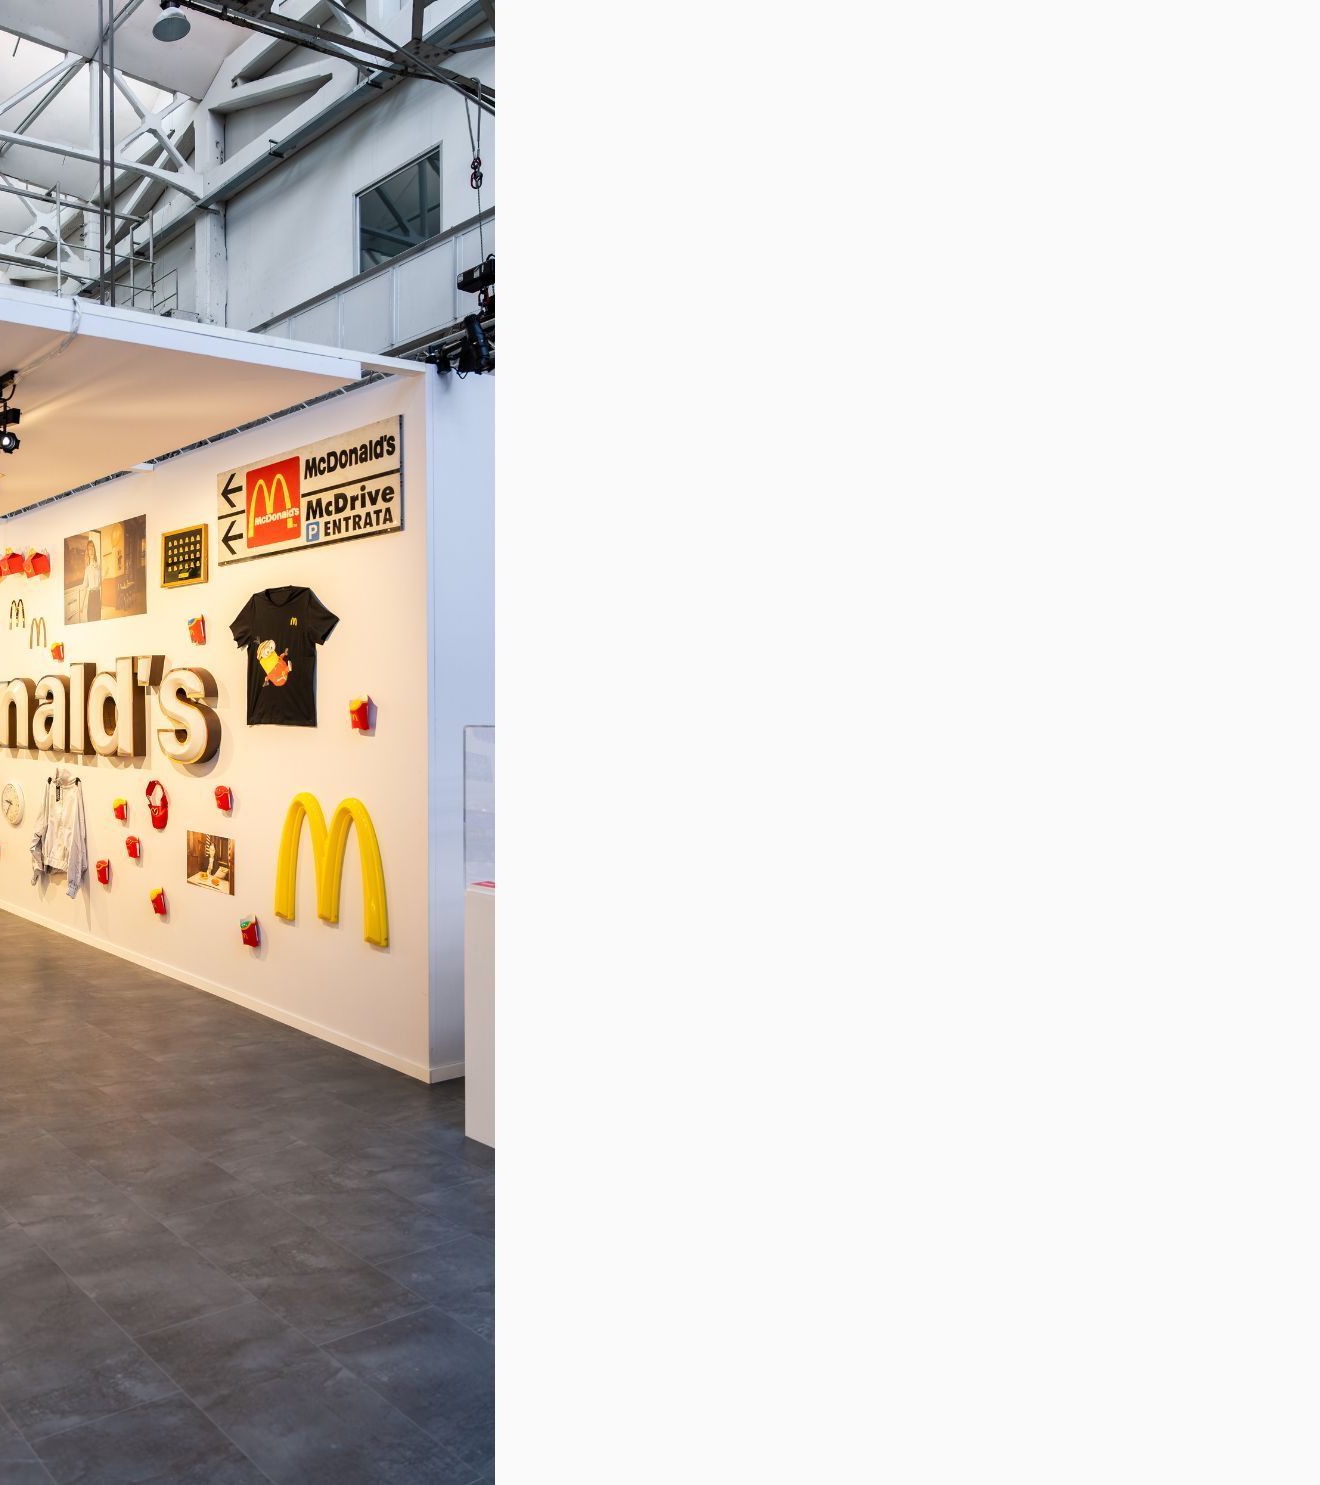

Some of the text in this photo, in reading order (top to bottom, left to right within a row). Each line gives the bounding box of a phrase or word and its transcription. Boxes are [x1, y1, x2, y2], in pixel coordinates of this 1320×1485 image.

[304, 434, 396, 480] McDonald's
[254, 507, 301, 527] McDonald's
[305, 484, 396, 521] McDrive
[308, 524, 319, 540] P
[324, 507, 394, 537] ENTRATA
